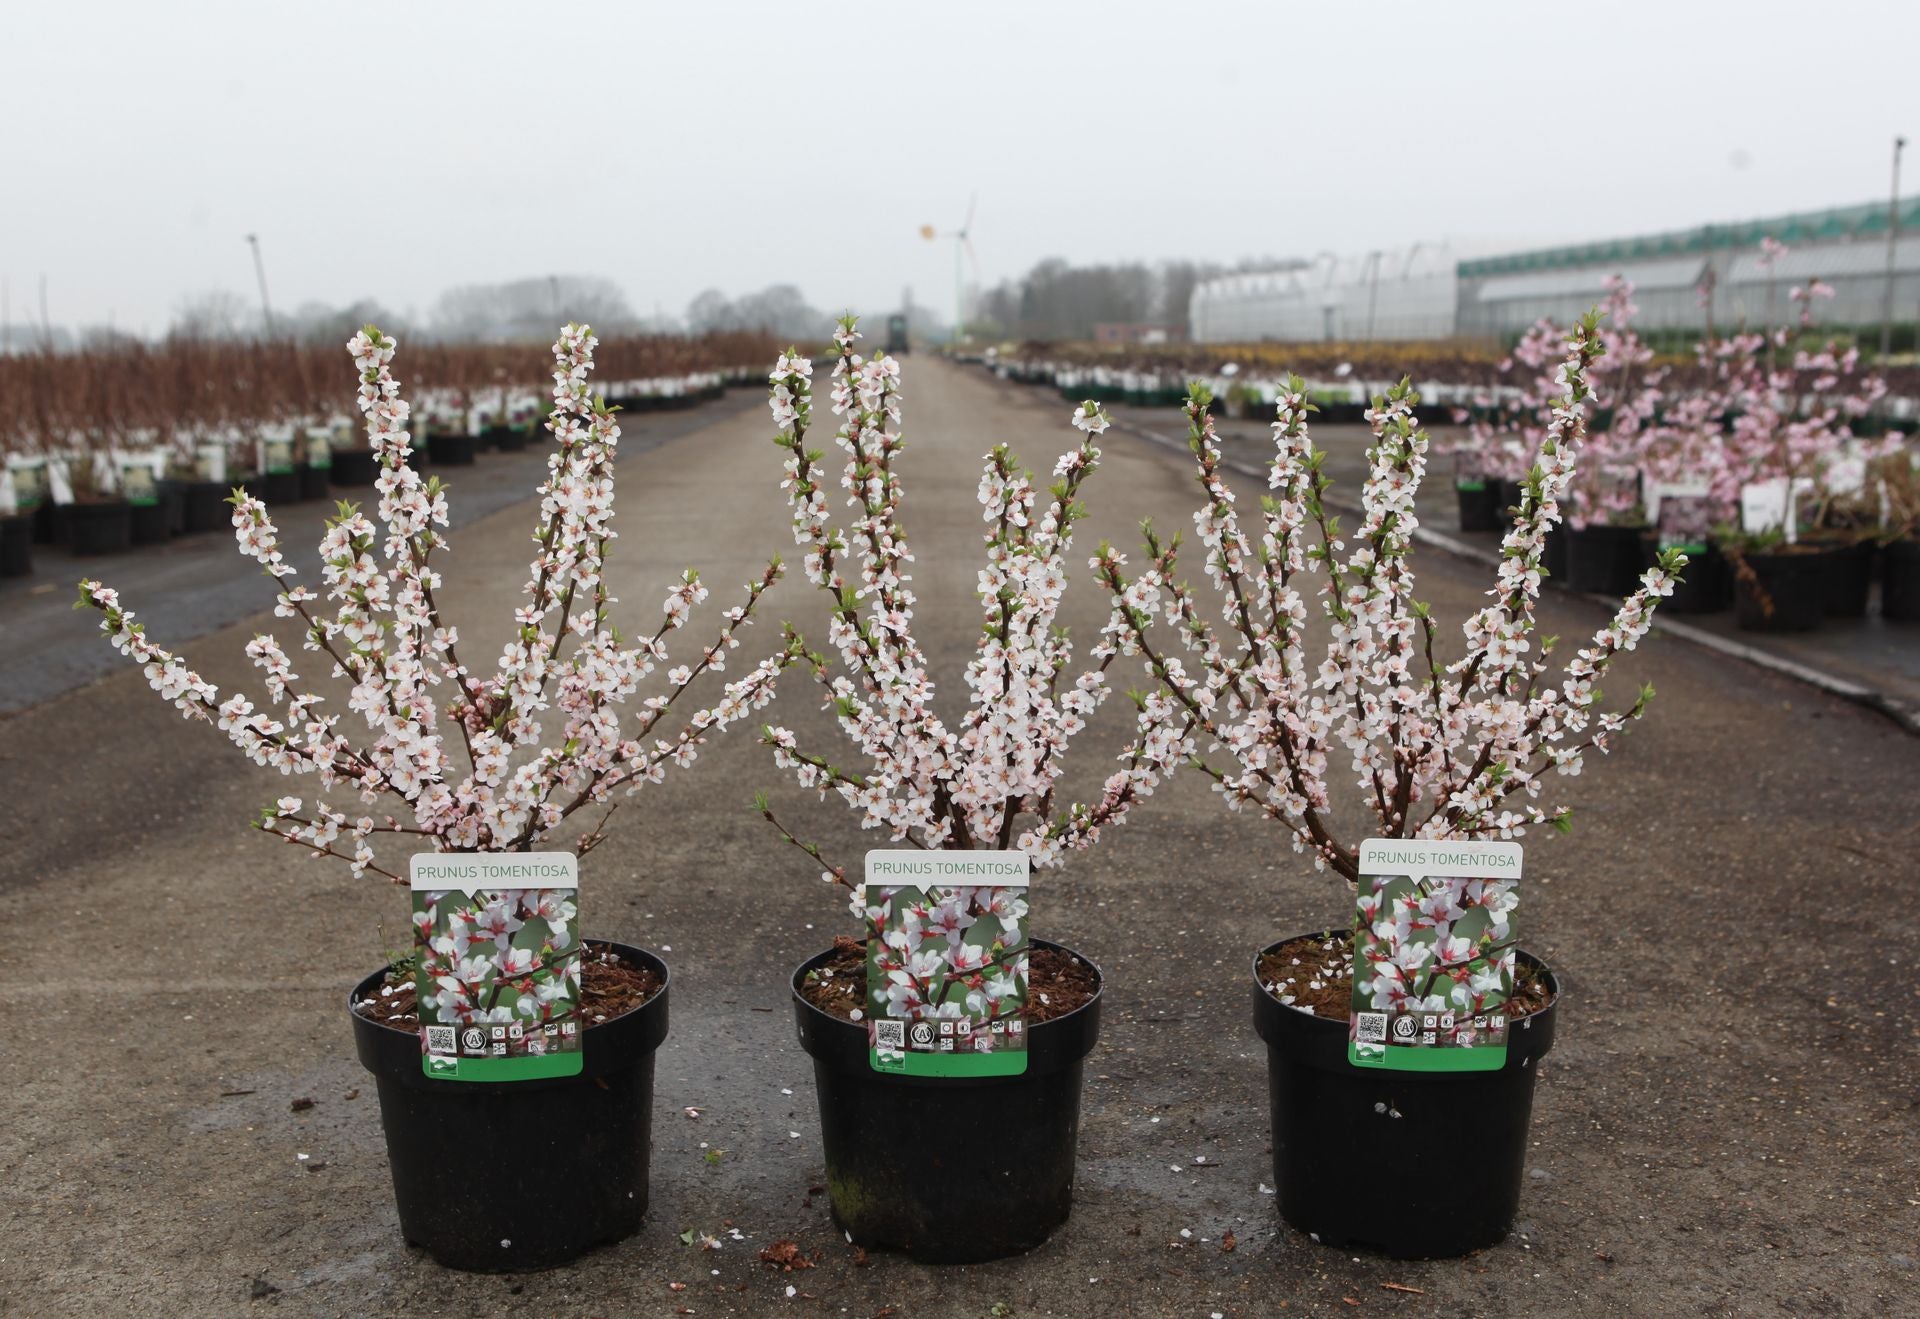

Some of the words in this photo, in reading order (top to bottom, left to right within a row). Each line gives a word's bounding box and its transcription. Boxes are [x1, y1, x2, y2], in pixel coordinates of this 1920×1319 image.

[1367, 851, 1426, 865] PRUNUS
[1430, 853, 1516, 867] TOMENTOSA
[417, 866, 478, 879] PRUNUS
[481, 865, 570, 878] TOMENTOSA
[873, 862, 932, 874] PRUNUS
[936, 863, 1023, 875] TOMENTOSA
